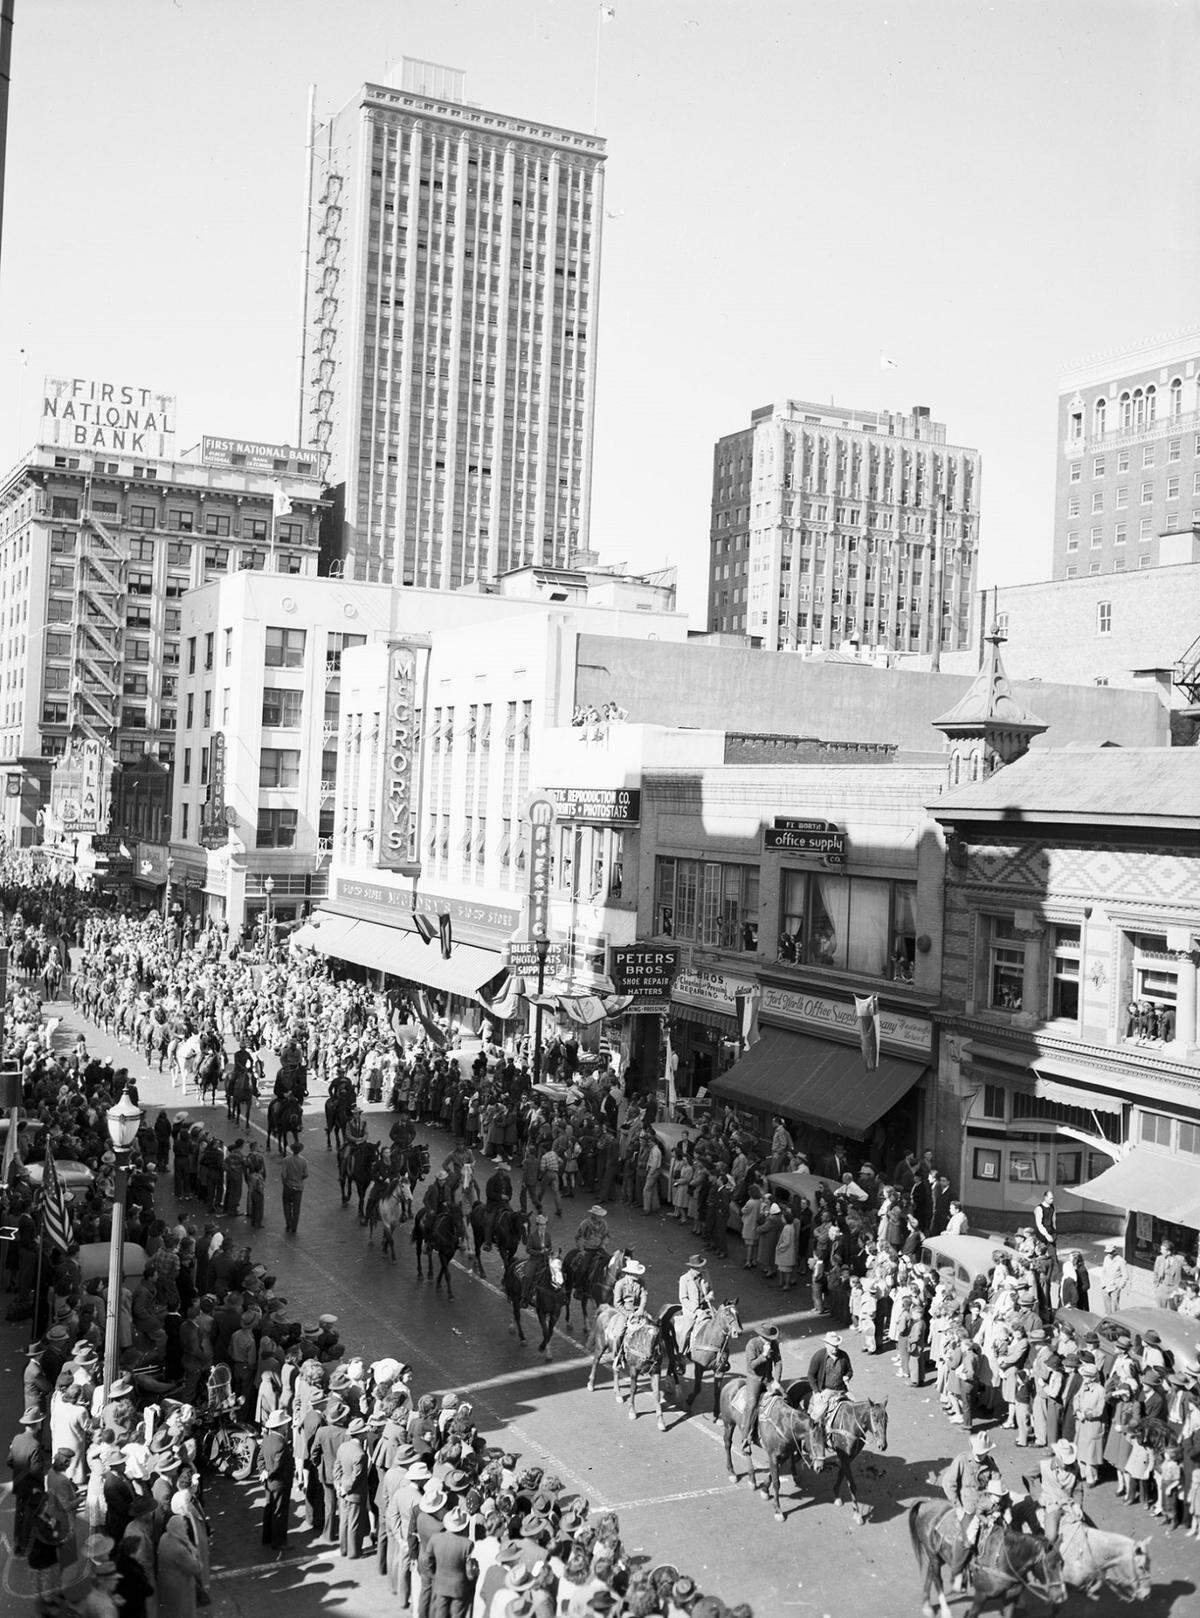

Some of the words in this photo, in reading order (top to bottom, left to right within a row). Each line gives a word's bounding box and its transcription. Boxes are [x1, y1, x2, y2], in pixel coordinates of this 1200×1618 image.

[72, 378, 152, 407] FIRST
[43, 397, 176, 434] NATIONAL
[74, 424, 146, 453] BANK
[206, 439, 234, 452] FIRST
[236, 443, 286, 459] NATIONAL
[289, 449, 318, 463] BANK
[83, 744, 98, 819] MILAM
[213, 736, 224, 818] CENTURY
[567, 789, 616, 804] REPRODUCTION
[618, 791, 631, 805] CO.
[583, 803, 629, 819] PHOTOSTATS
[775, 832, 806, 847] office
[808, 834, 843, 853] supply
[531, 802, 551, 937] MAJESTIC
[511, 944, 531, 953] BLUE
[511, 955, 561, 964] PHOTOATS
[616, 953, 675, 964] PETERS
[517, 965, 556, 975] SUPPIES
[626, 965, 666, 975] BROS.
[622, 977, 641, 985] SHOE
[643, 977, 669, 985] REPAIR
[680, 984, 719, 999] REPAIRING
[766, 990, 782, 1009] Fort
[782, 993, 804, 1011] Worth
[804, 999, 831, 1017] Office
[831, 1004, 859, 1026] Supply
